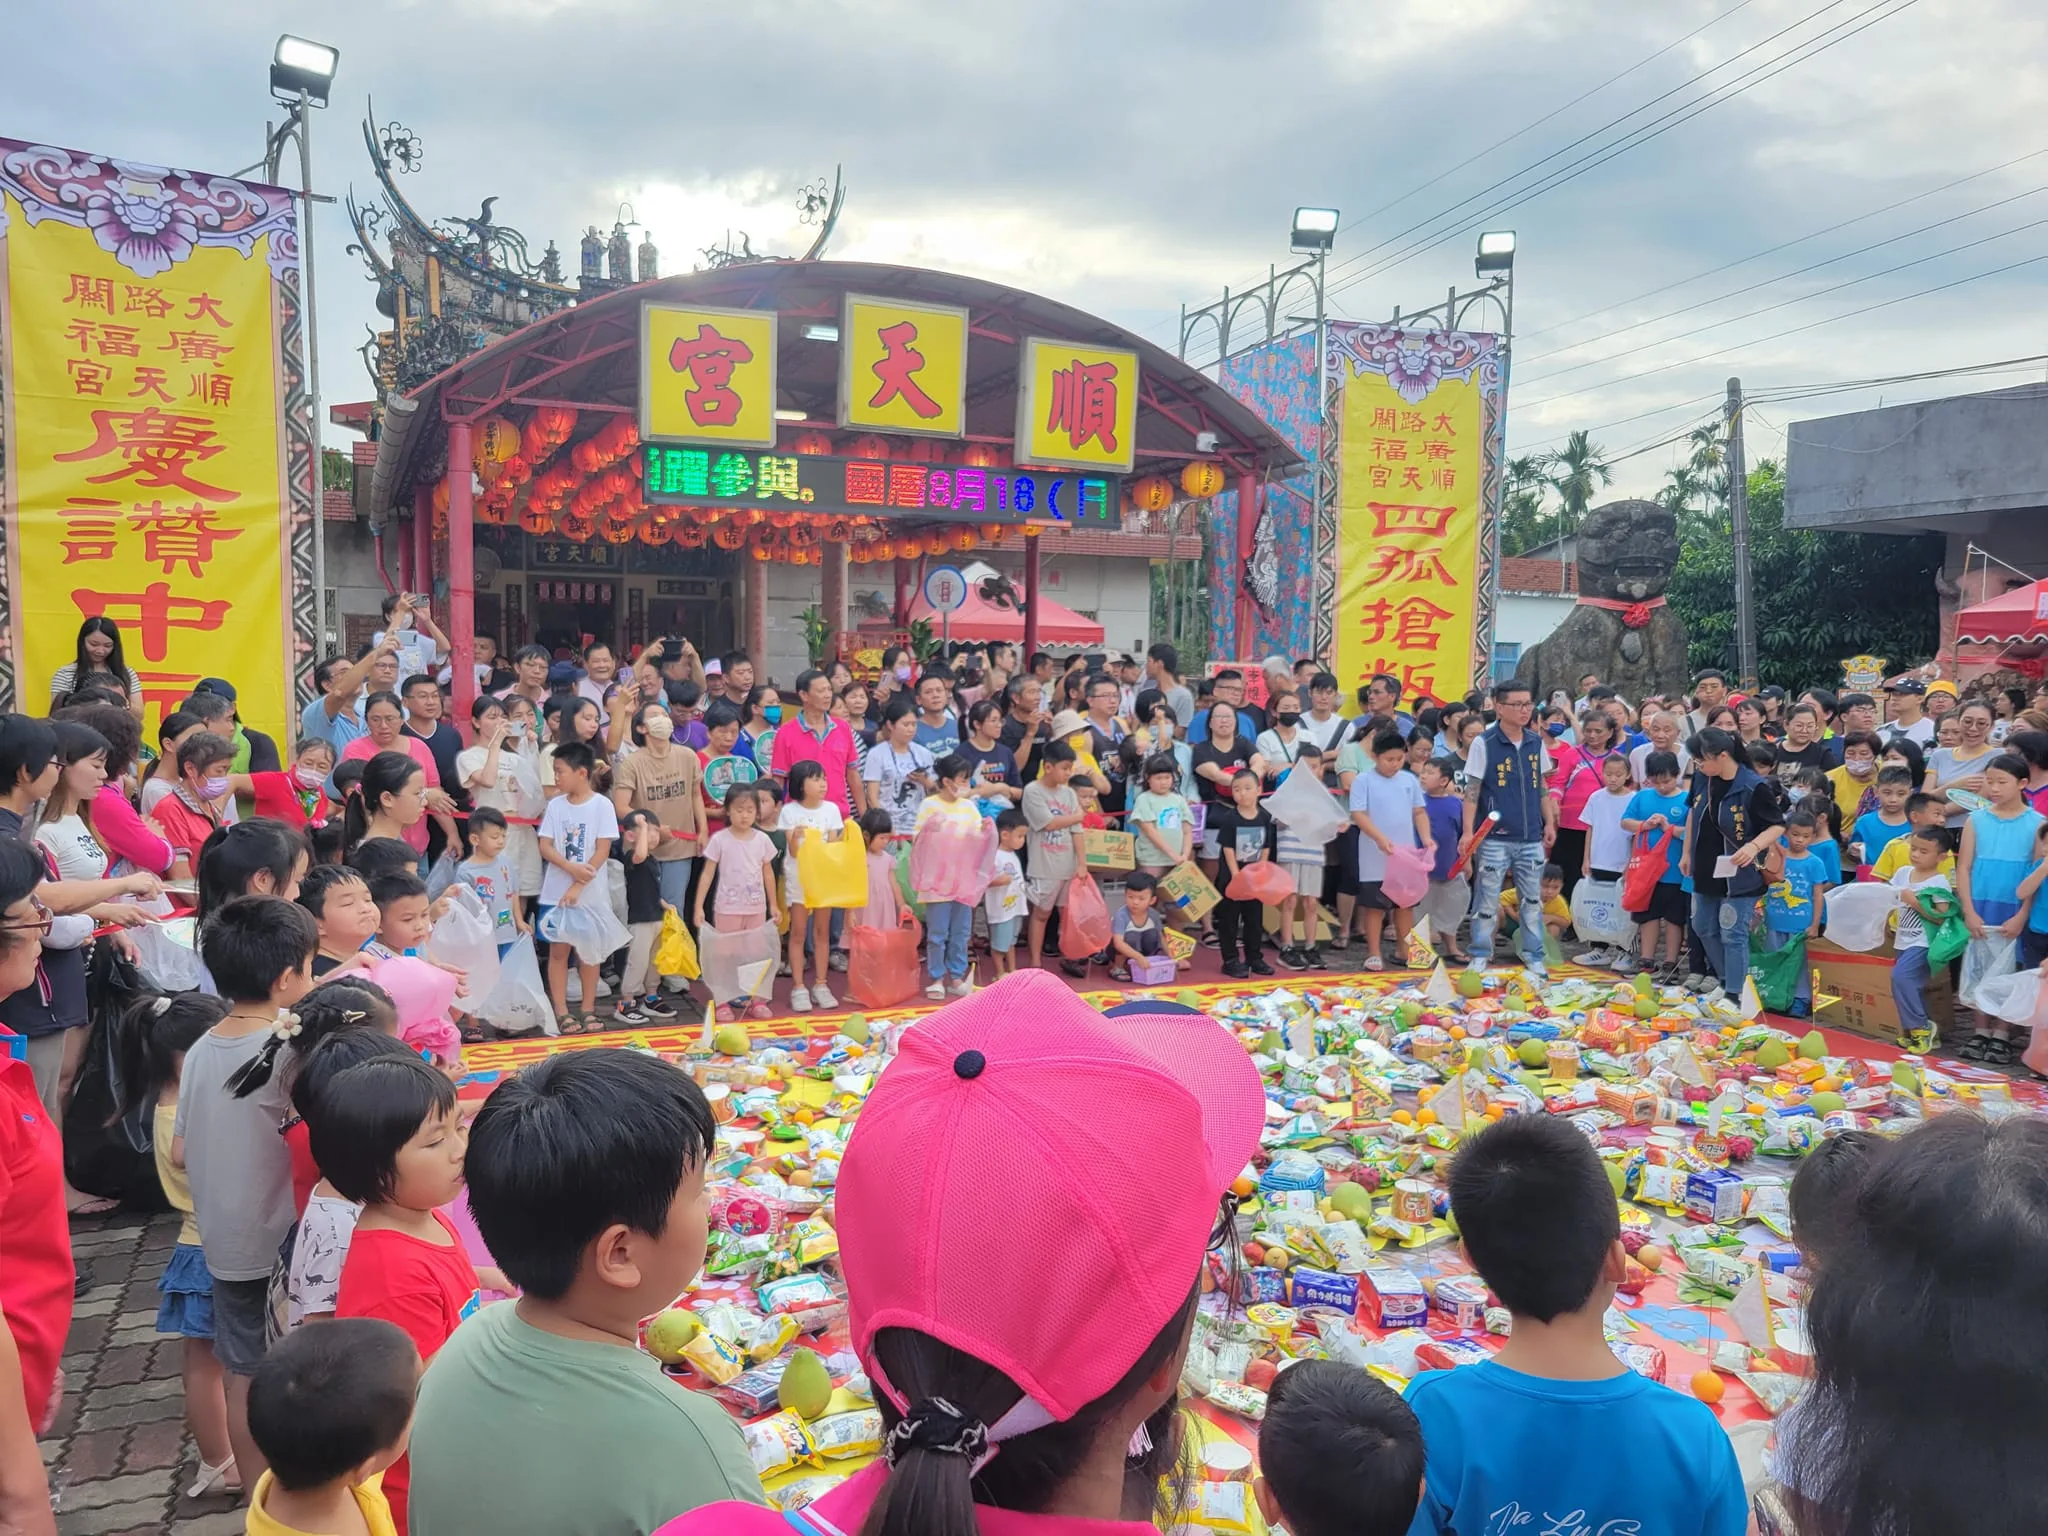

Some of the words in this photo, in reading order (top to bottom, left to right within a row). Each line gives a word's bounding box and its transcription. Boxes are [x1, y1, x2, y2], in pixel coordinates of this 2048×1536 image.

[67, 358, 234, 407] 順天宮
[669, 320, 1117, 454] 順天宮
[1369, 463, 1457, 492] 順天宮
